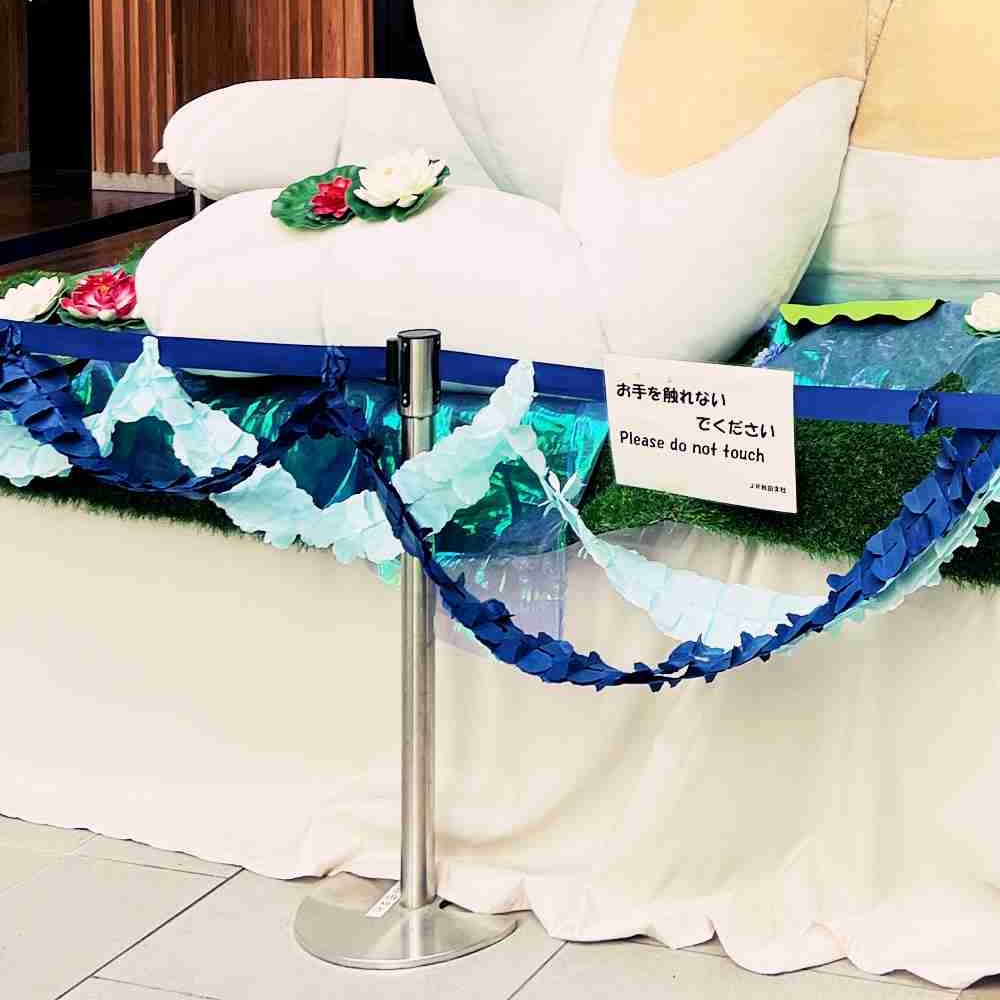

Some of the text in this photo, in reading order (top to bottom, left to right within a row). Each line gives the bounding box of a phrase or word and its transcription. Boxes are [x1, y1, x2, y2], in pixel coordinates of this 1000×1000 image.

[616, 382, 726, 407] お手を触れない
[696, 416, 776, 439] でください
[620, 430, 765, 463] Please do not touch
